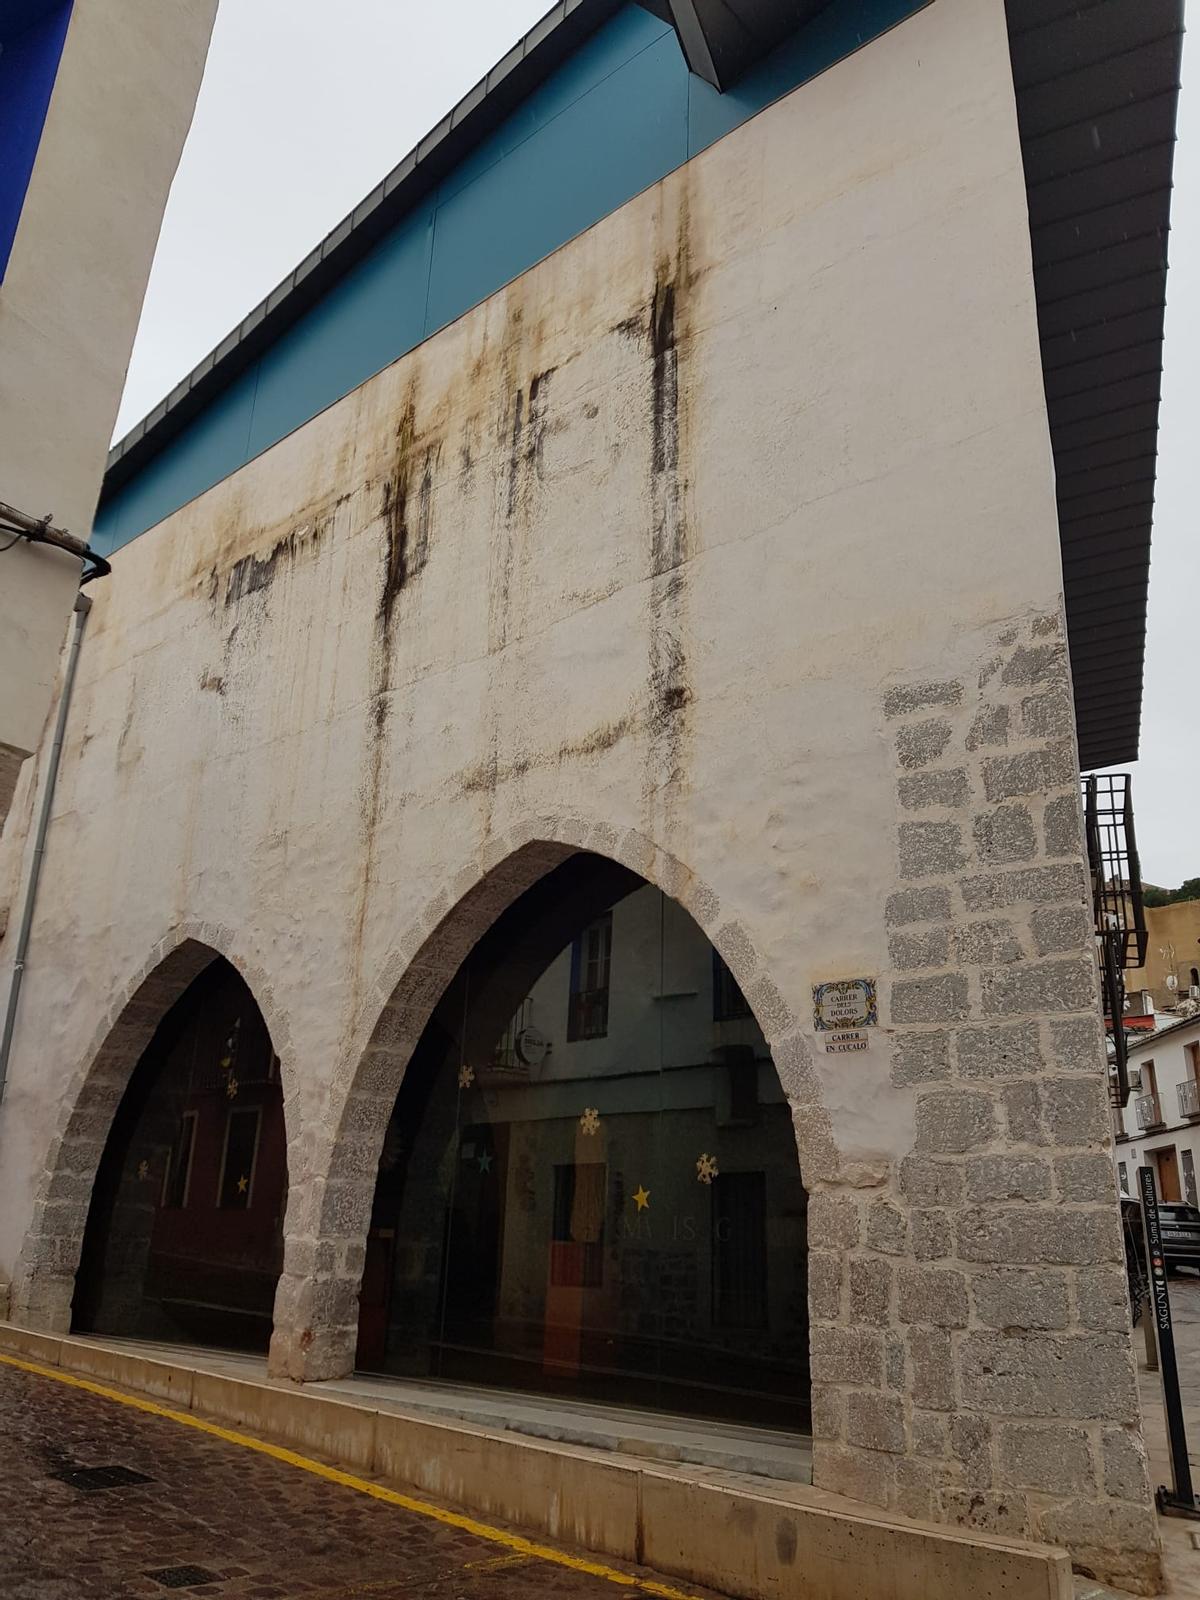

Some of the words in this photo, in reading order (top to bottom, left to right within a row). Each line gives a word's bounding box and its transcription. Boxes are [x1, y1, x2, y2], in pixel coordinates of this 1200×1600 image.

[831, 994, 857, 1002] CARRER
[830, 1008, 858, 1016] DOLORS
[832, 1033, 860, 1041] CARRER
[1144, 1173, 1155, 1207] Cultures
[1147, 1208, 1156, 1219] de
[1150, 1221, 1160, 1245] Suma
